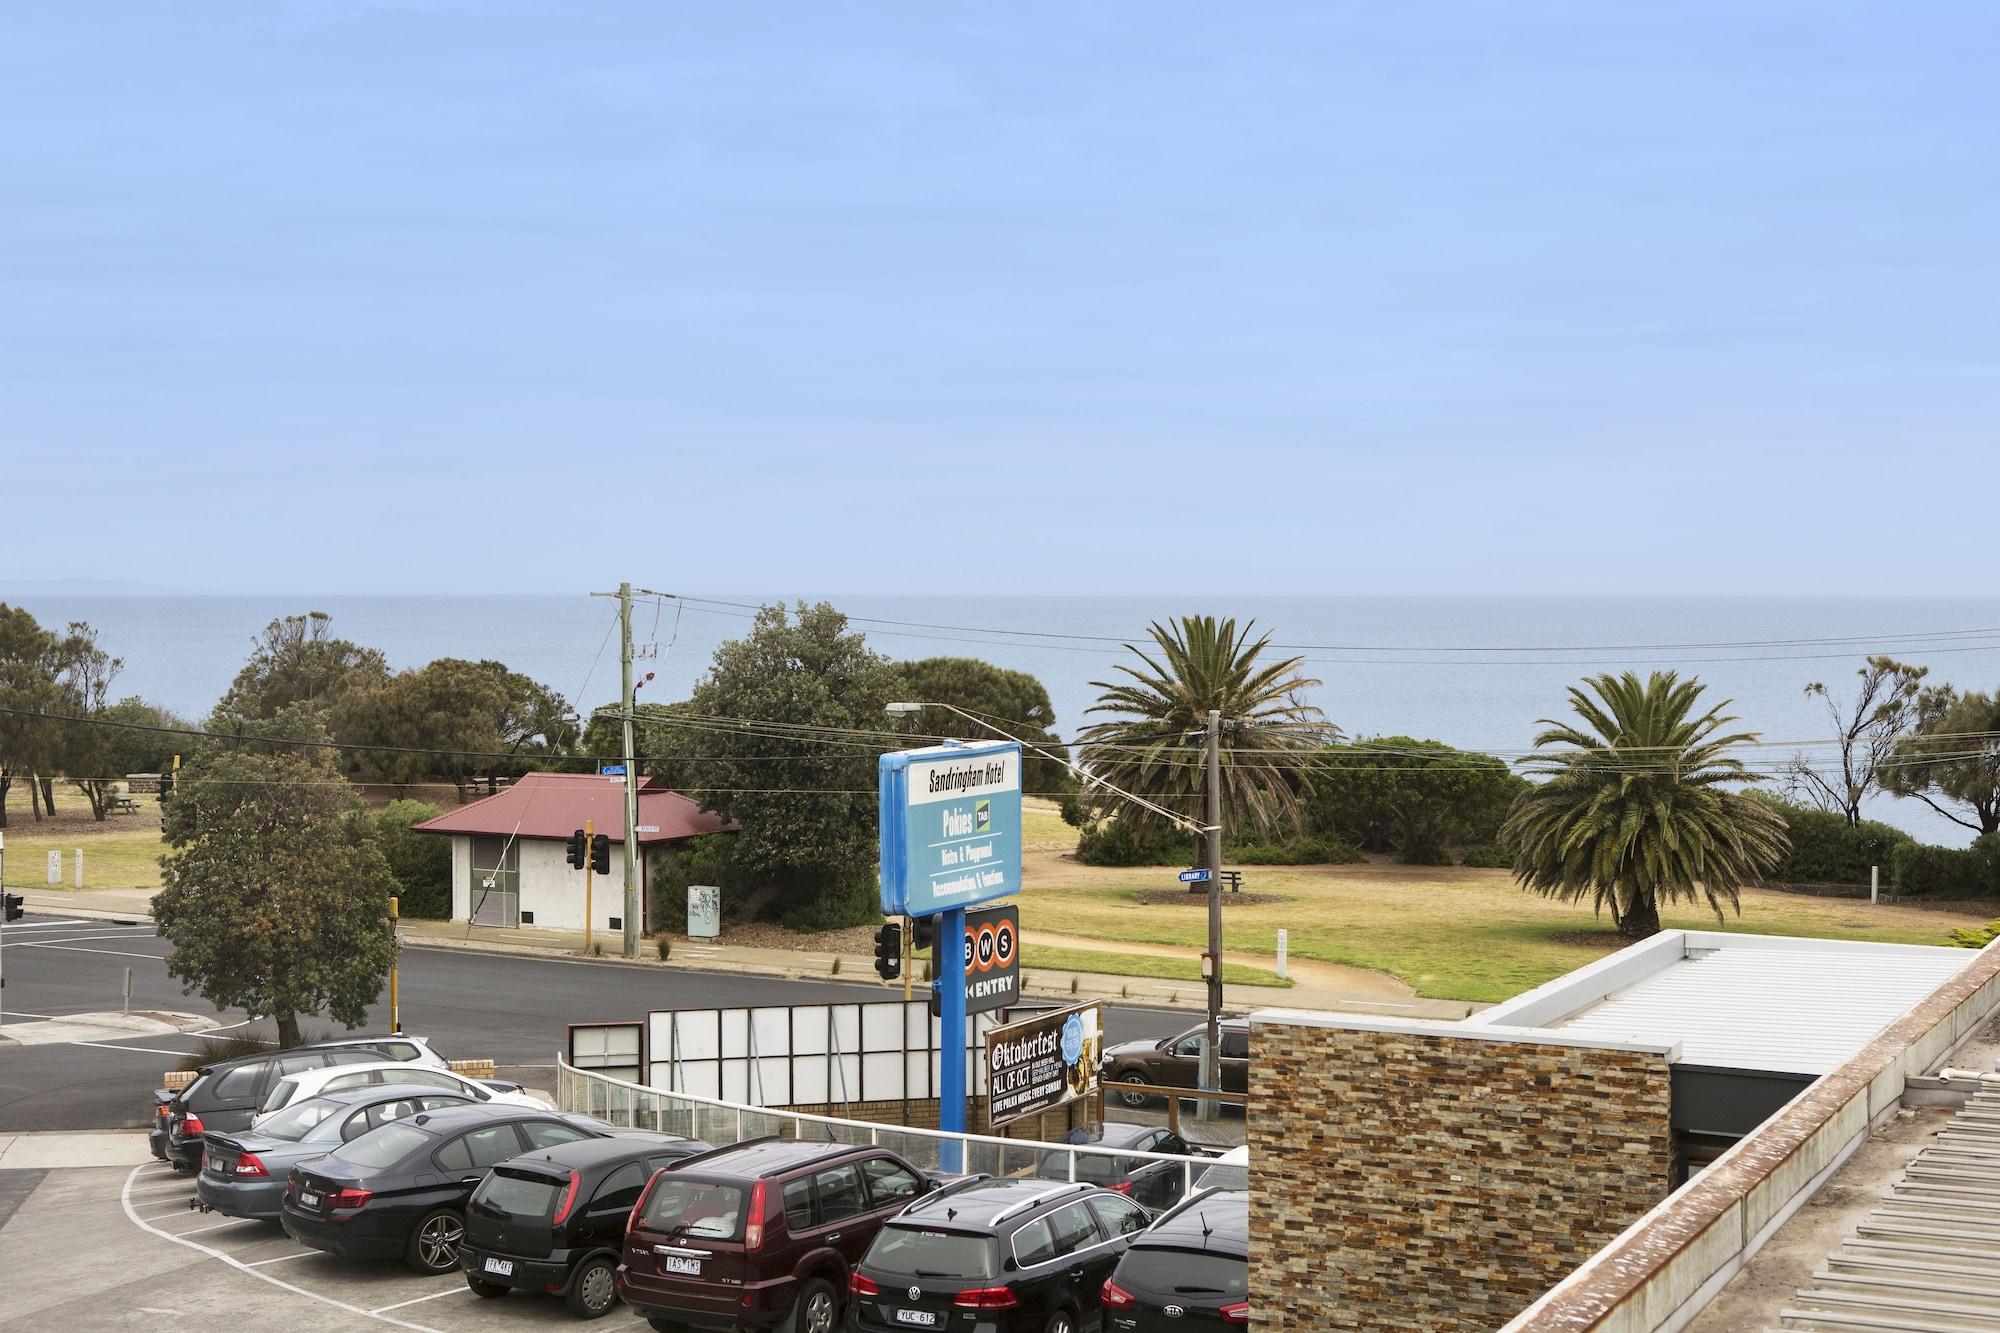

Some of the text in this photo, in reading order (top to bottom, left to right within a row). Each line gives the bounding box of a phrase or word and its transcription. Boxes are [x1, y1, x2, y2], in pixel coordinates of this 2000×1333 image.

[929, 760, 1005, 793] Sandringham Hotel
[943, 807, 973, 838] Pokies
[977, 811, 988, 822] TAB
[942, 848, 958, 867] Bistro
[1181, 872, 1200, 881] LIBRARY
[965, 934, 1009, 960] BWS
[976, 975, 1013, 998] ENTRY
[992, 1029, 1058, 1071] Oktoberfest
[993, 1075, 1006, 1096] ALL
[1007, 1071, 1016, 1090] OF
[1017, 1066, 1031, 1087] OCT
[993, 1100, 1003, 1114] LIVE
[1003, 1095, 1017, 1110] POLKA
[1018, 1090, 1031, 1104] MUSIC
[1031, 1085, 1045, 1099] EVERY
[1045, 1080, 1062, 1095] SUNDAY
[901, 1310, 915, 1321] YUC
[1166, 1306, 1182, 1316] KIA
